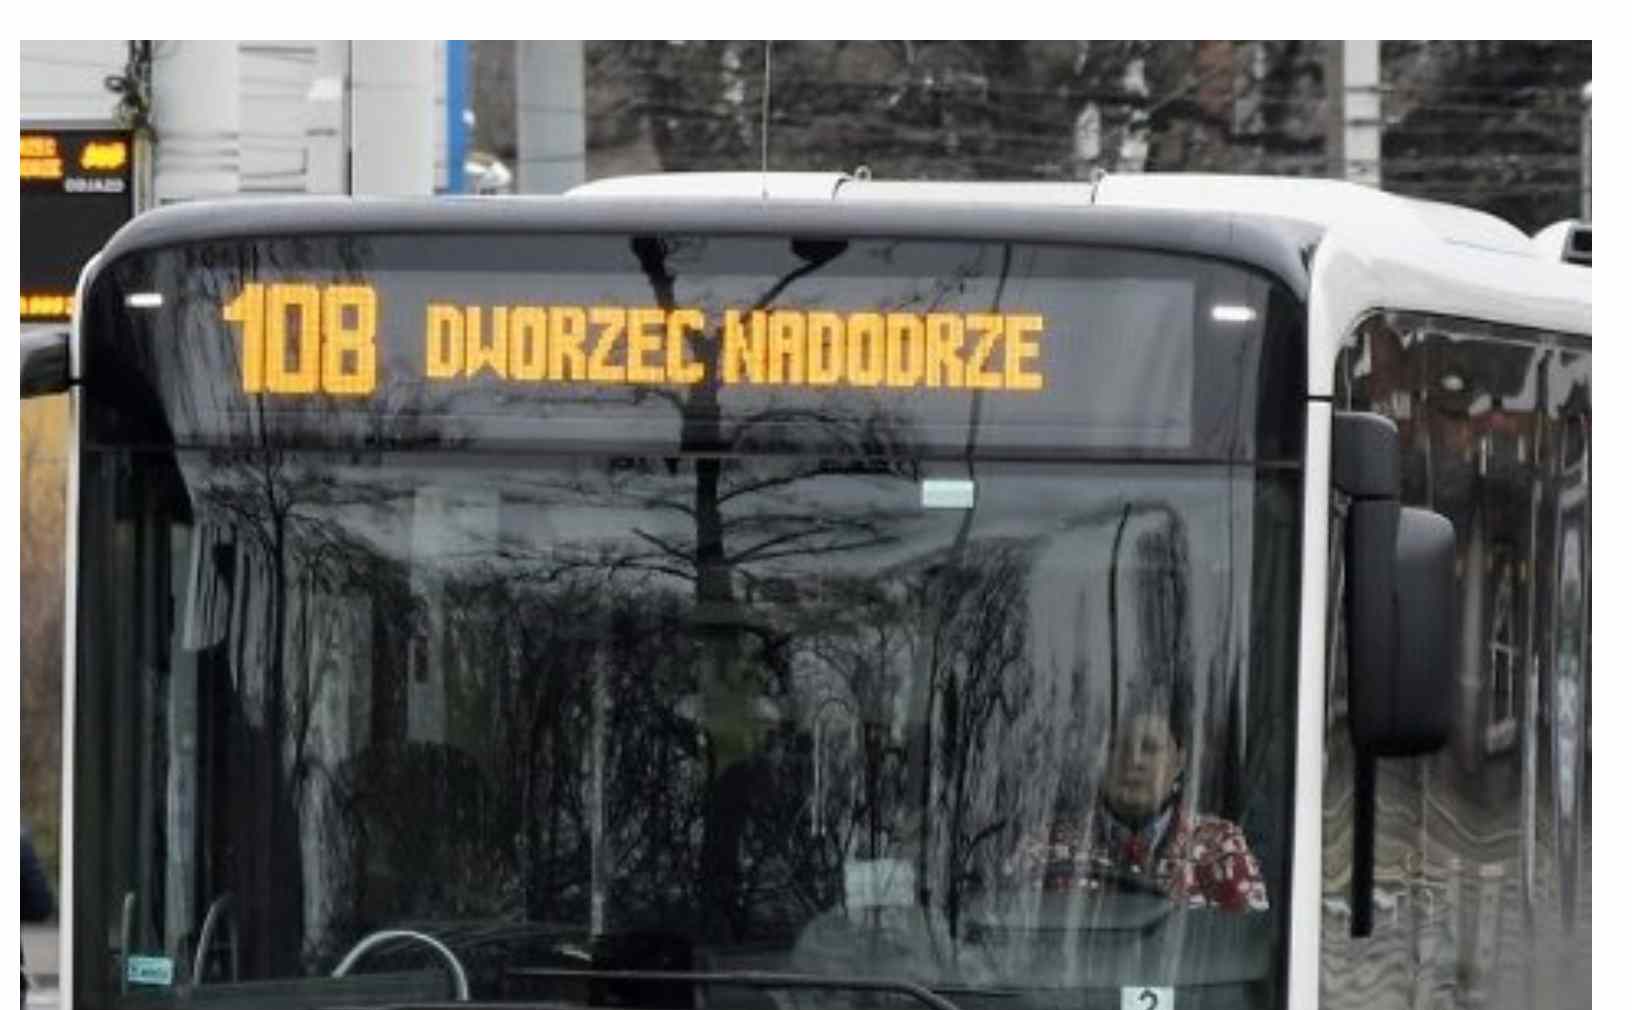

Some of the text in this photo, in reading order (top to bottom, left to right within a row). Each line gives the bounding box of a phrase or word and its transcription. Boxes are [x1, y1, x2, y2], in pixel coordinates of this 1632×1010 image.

[223, 282, 1043, 395] 108 DWORZEC NADODRZE
